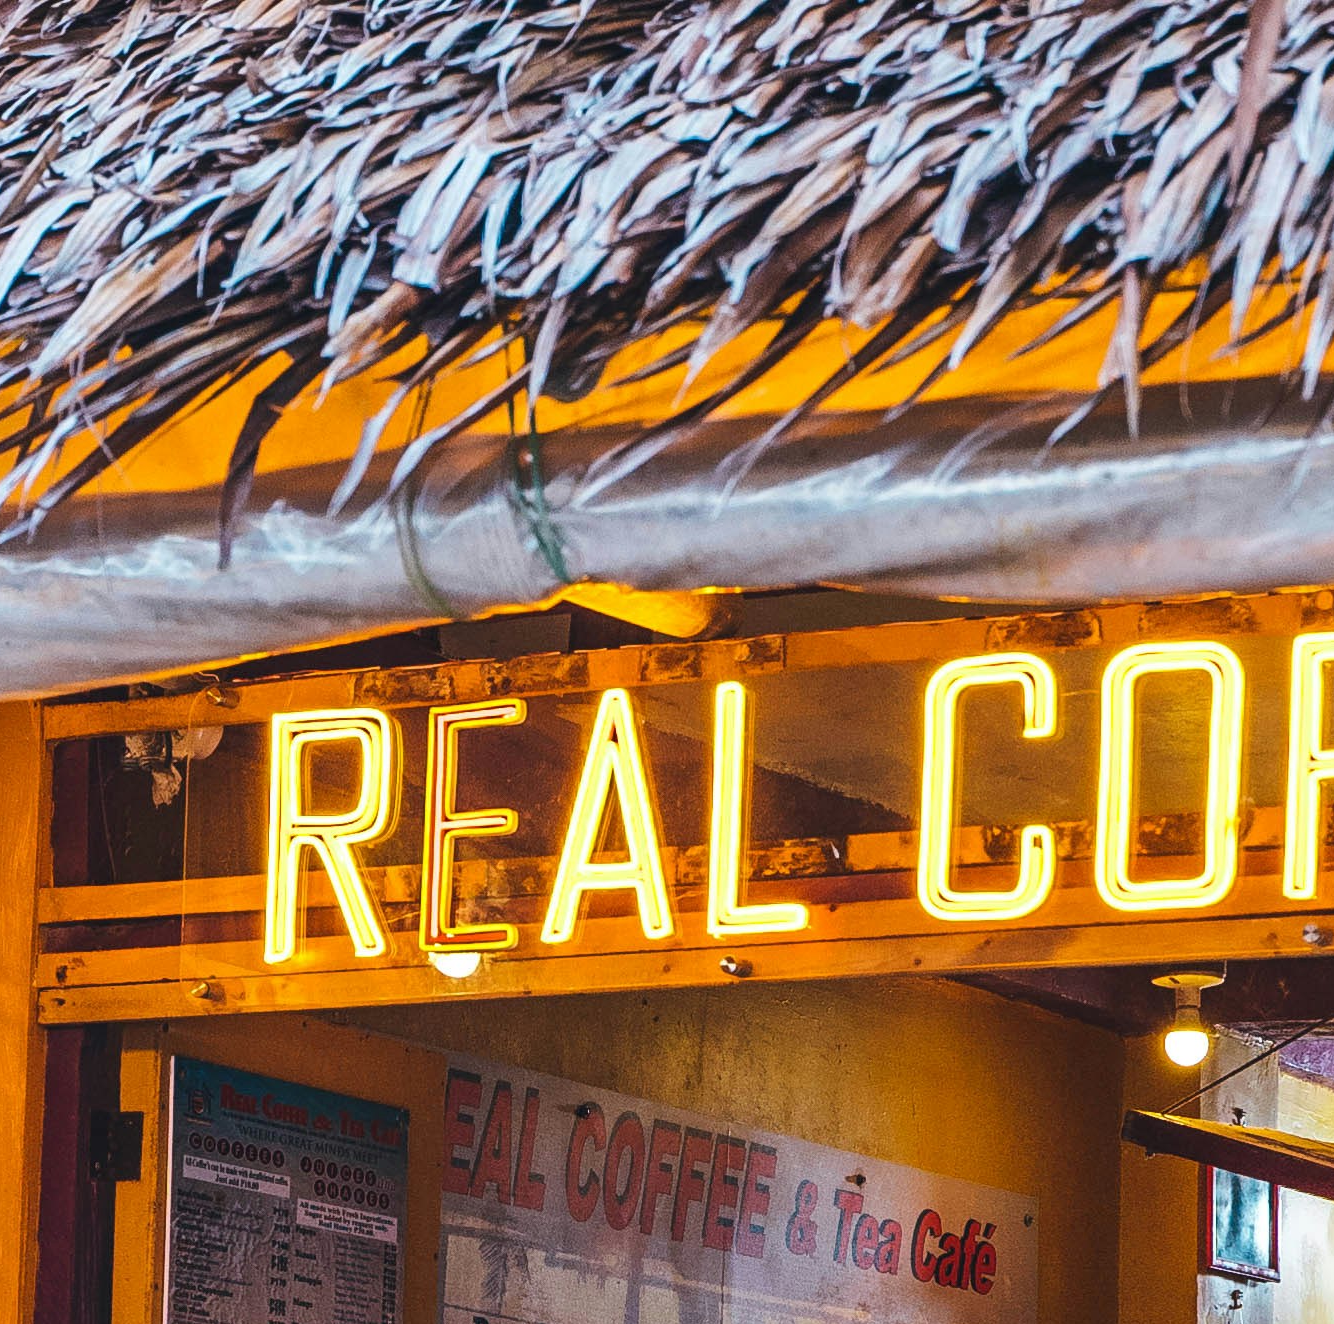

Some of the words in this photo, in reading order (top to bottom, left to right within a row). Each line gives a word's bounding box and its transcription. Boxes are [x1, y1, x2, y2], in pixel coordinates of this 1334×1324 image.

[264, 680, 809, 964] REAL
[442, 1068, 546, 1213] EAL
[566, 1101, 777, 1259] COFFEE
[786, 1178, 818, 1256] &
[834, 1187, 902, 1275] Tea
[911, 1208, 997, 1294] Café
